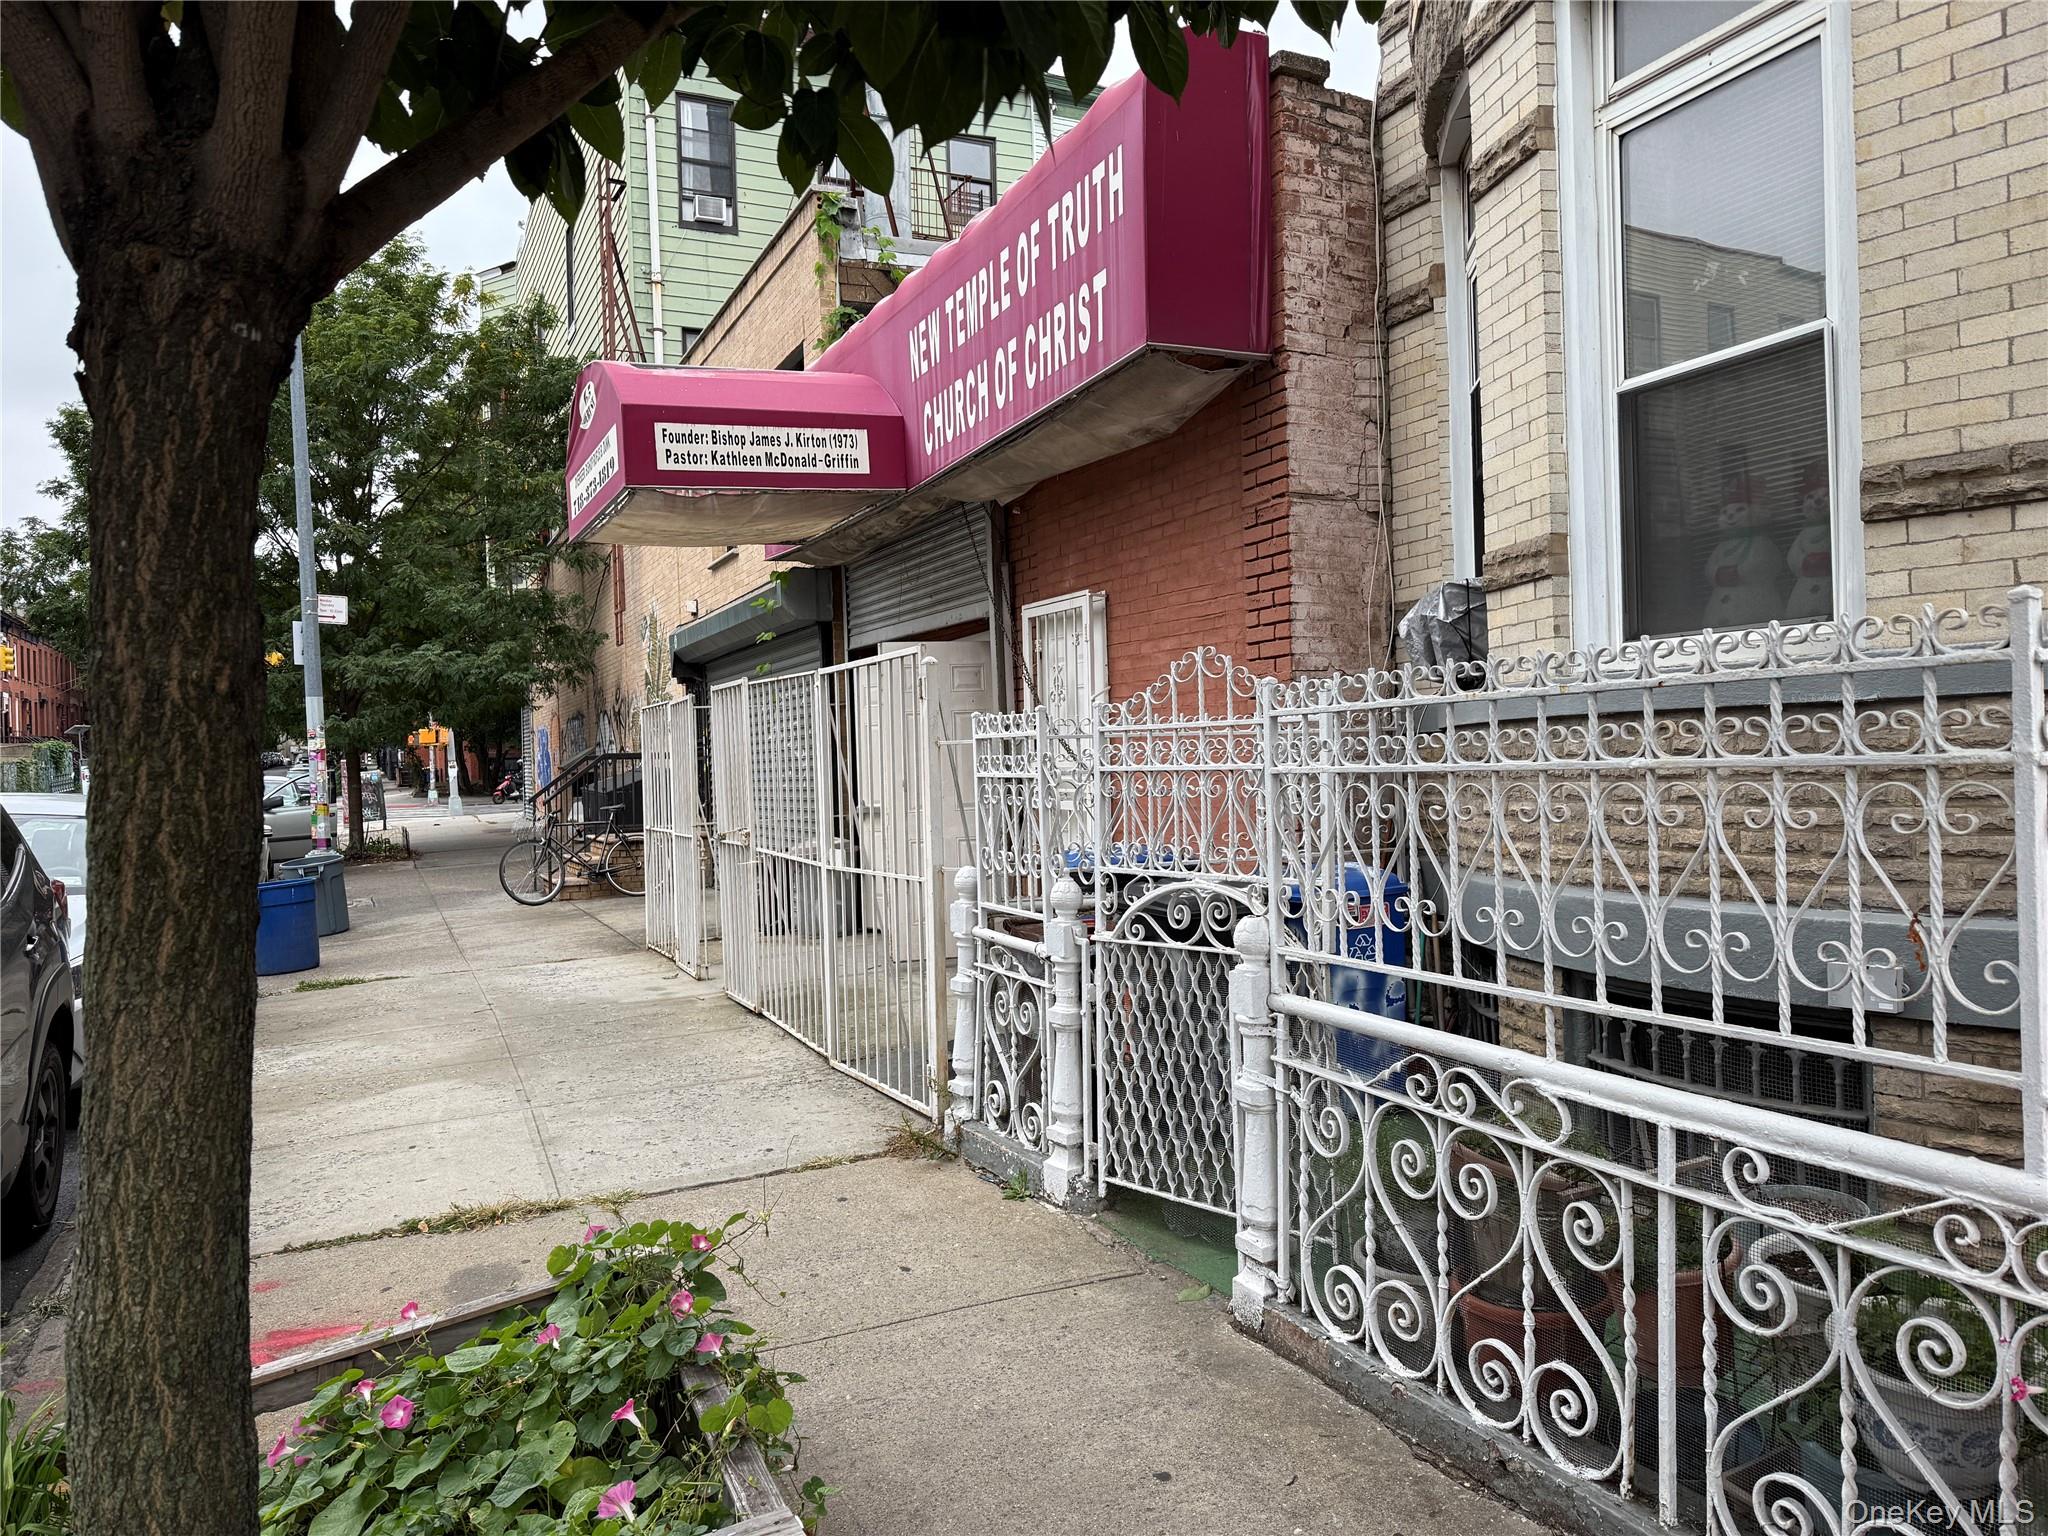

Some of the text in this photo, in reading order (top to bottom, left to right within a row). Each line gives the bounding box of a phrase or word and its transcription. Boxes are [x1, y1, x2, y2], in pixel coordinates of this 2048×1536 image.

[909, 144, 1124, 383] NEW TEMPLE OF TRUTH
[923, 268, 1107, 456] CHURCH OF CHRIST
[662, 428, 858, 450] Founder: Bishop James J. Kirton (1973)
[665, 449, 859, 469] Pastor: Kathleen McDonald-Griffin
